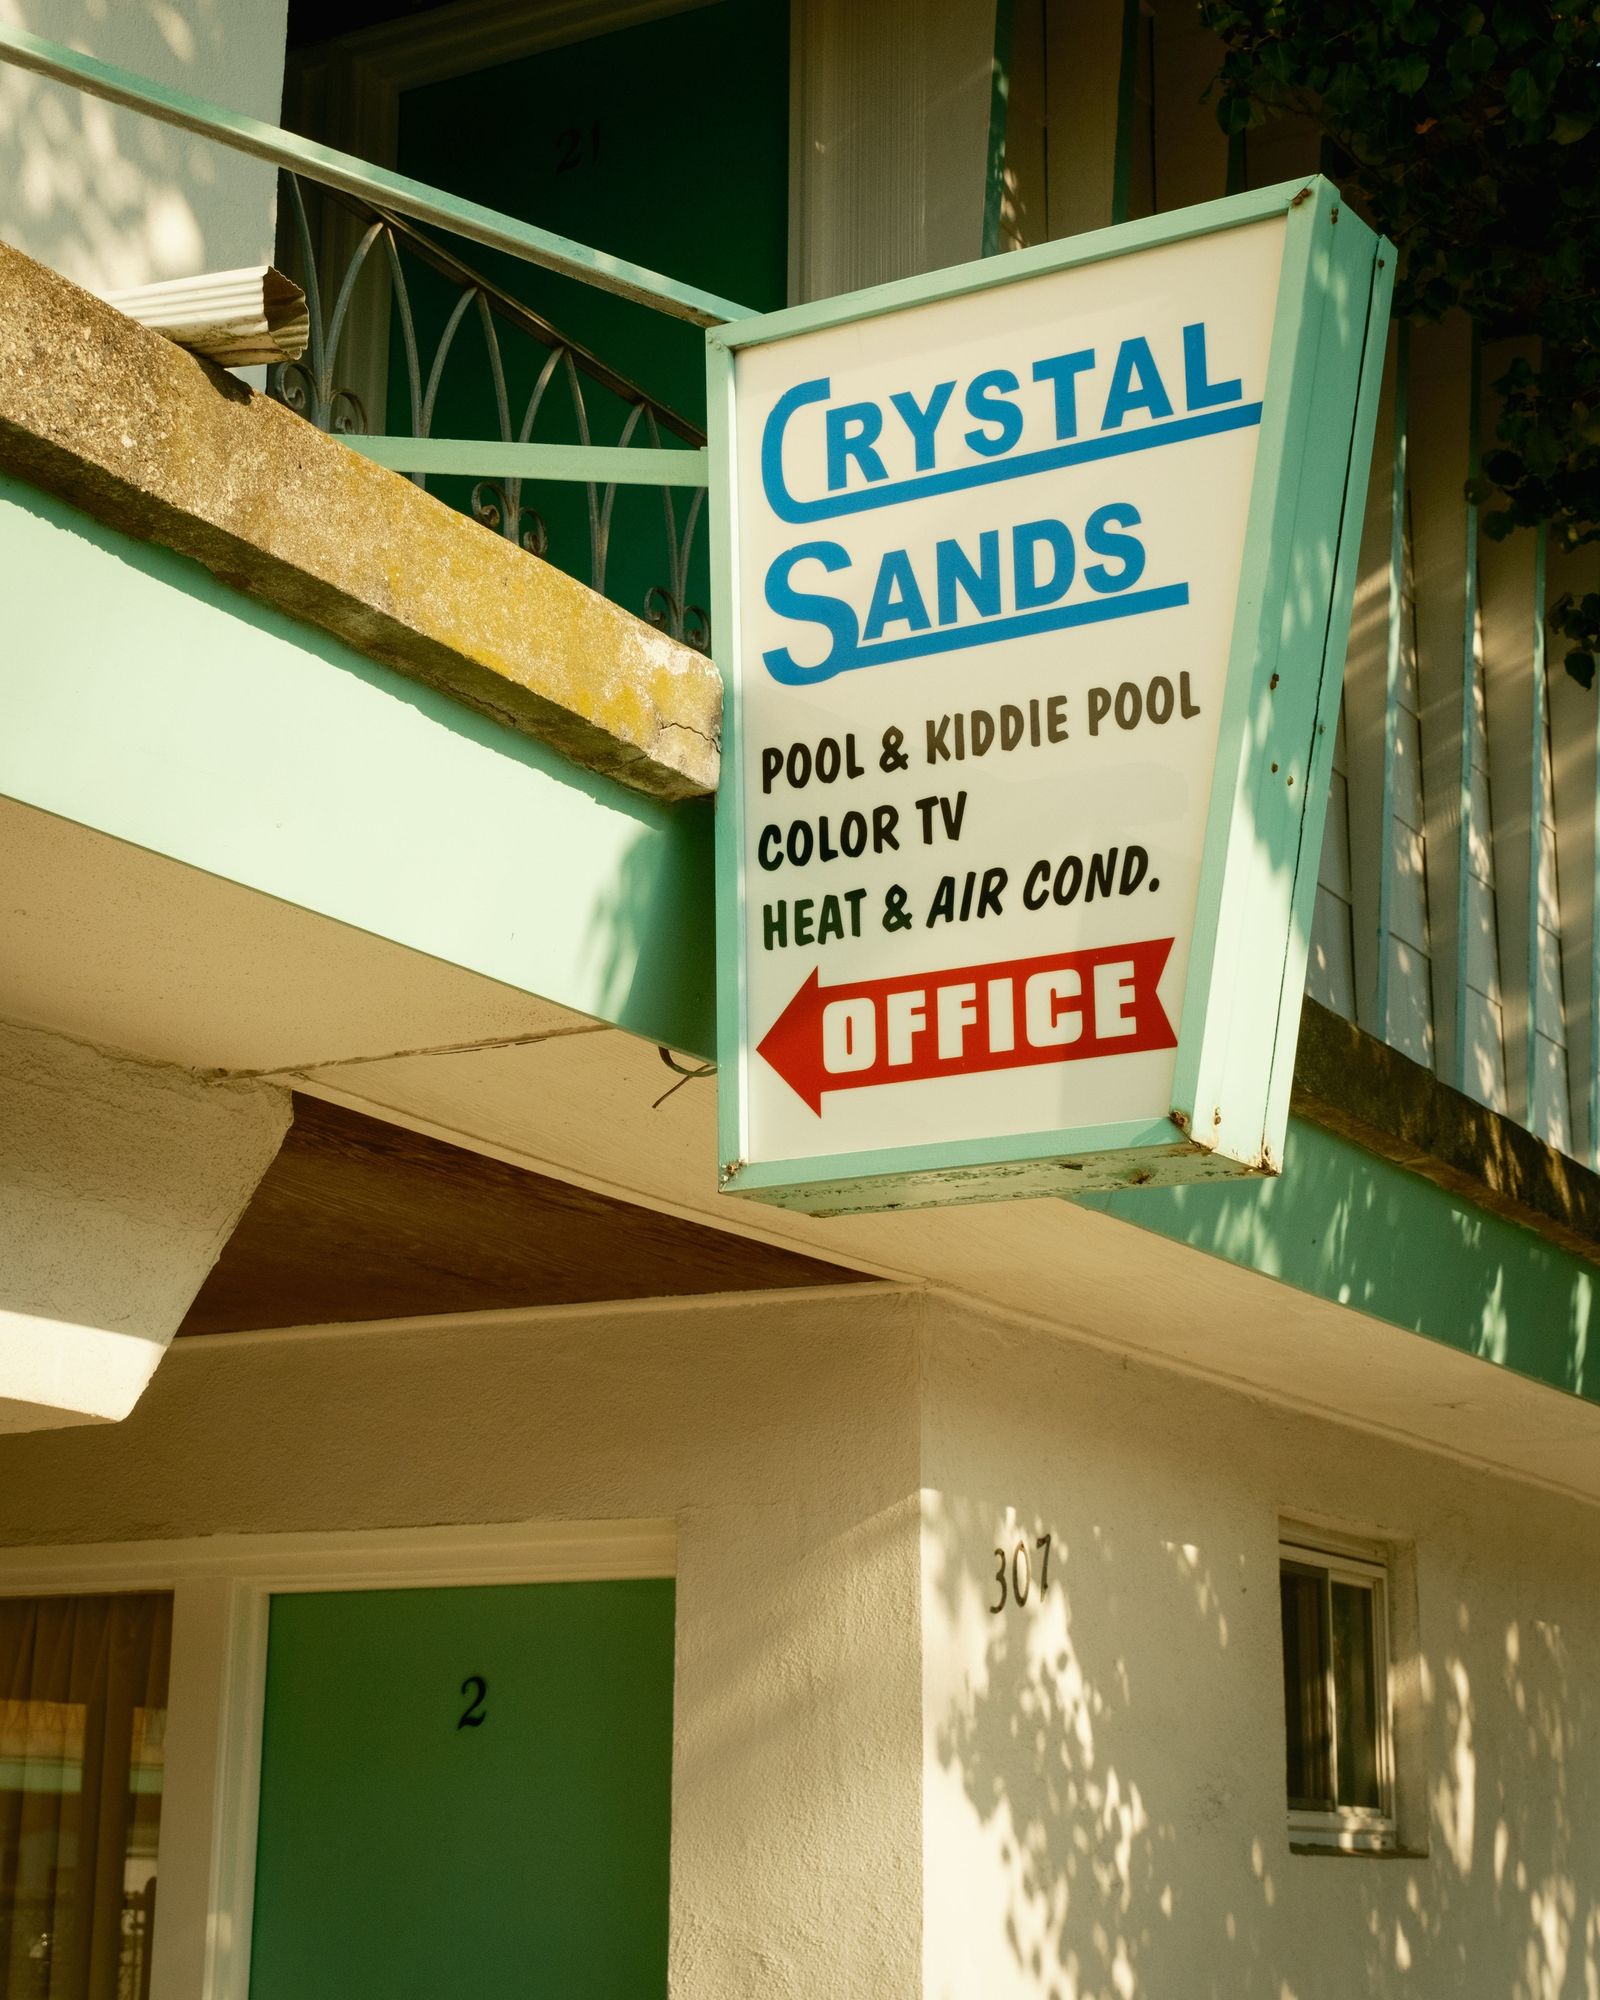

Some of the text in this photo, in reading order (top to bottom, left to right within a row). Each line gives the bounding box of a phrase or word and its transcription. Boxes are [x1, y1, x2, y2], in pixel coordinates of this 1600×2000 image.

[553, 119, 601, 176] 21
[761, 321, 1263, 525] CRYSTAL
[761, 502, 1189, 687] SANDS
[762, 670, 1201, 795] POOL & KIDDIE POOL
[757, 790, 968, 872] COLOR TV
[762, 844, 1160, 952] HEAT & AIR COND.
[822, 959, 1138, 1075] OFFICE
[989, 1533, 1052, 1614] 307
[456, 1675, 487, 1731] 2
